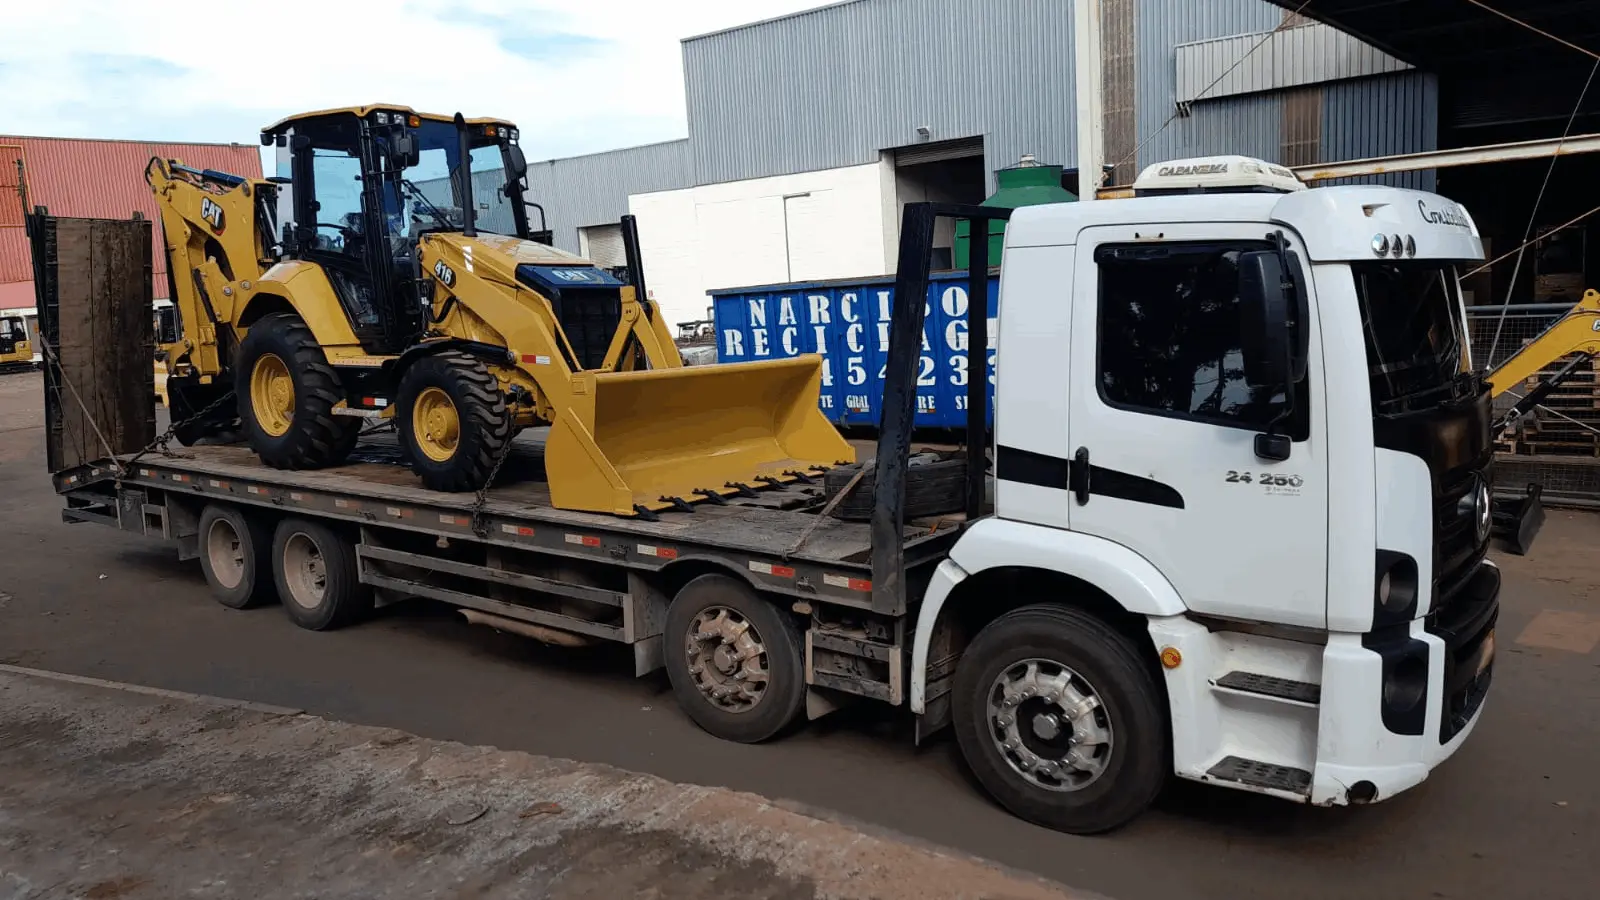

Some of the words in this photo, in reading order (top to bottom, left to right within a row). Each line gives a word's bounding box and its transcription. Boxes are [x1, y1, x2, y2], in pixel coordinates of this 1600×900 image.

[1158, 163, 1229, 177] CAPANEMA
[201, 197, 222, 228] CAT
[434, 260, 453, 285] 416
[551, 269, 590, 281] CAT
[1225, 470, 1253, 484] 24
[1259, 473, 1304, 487] 250
